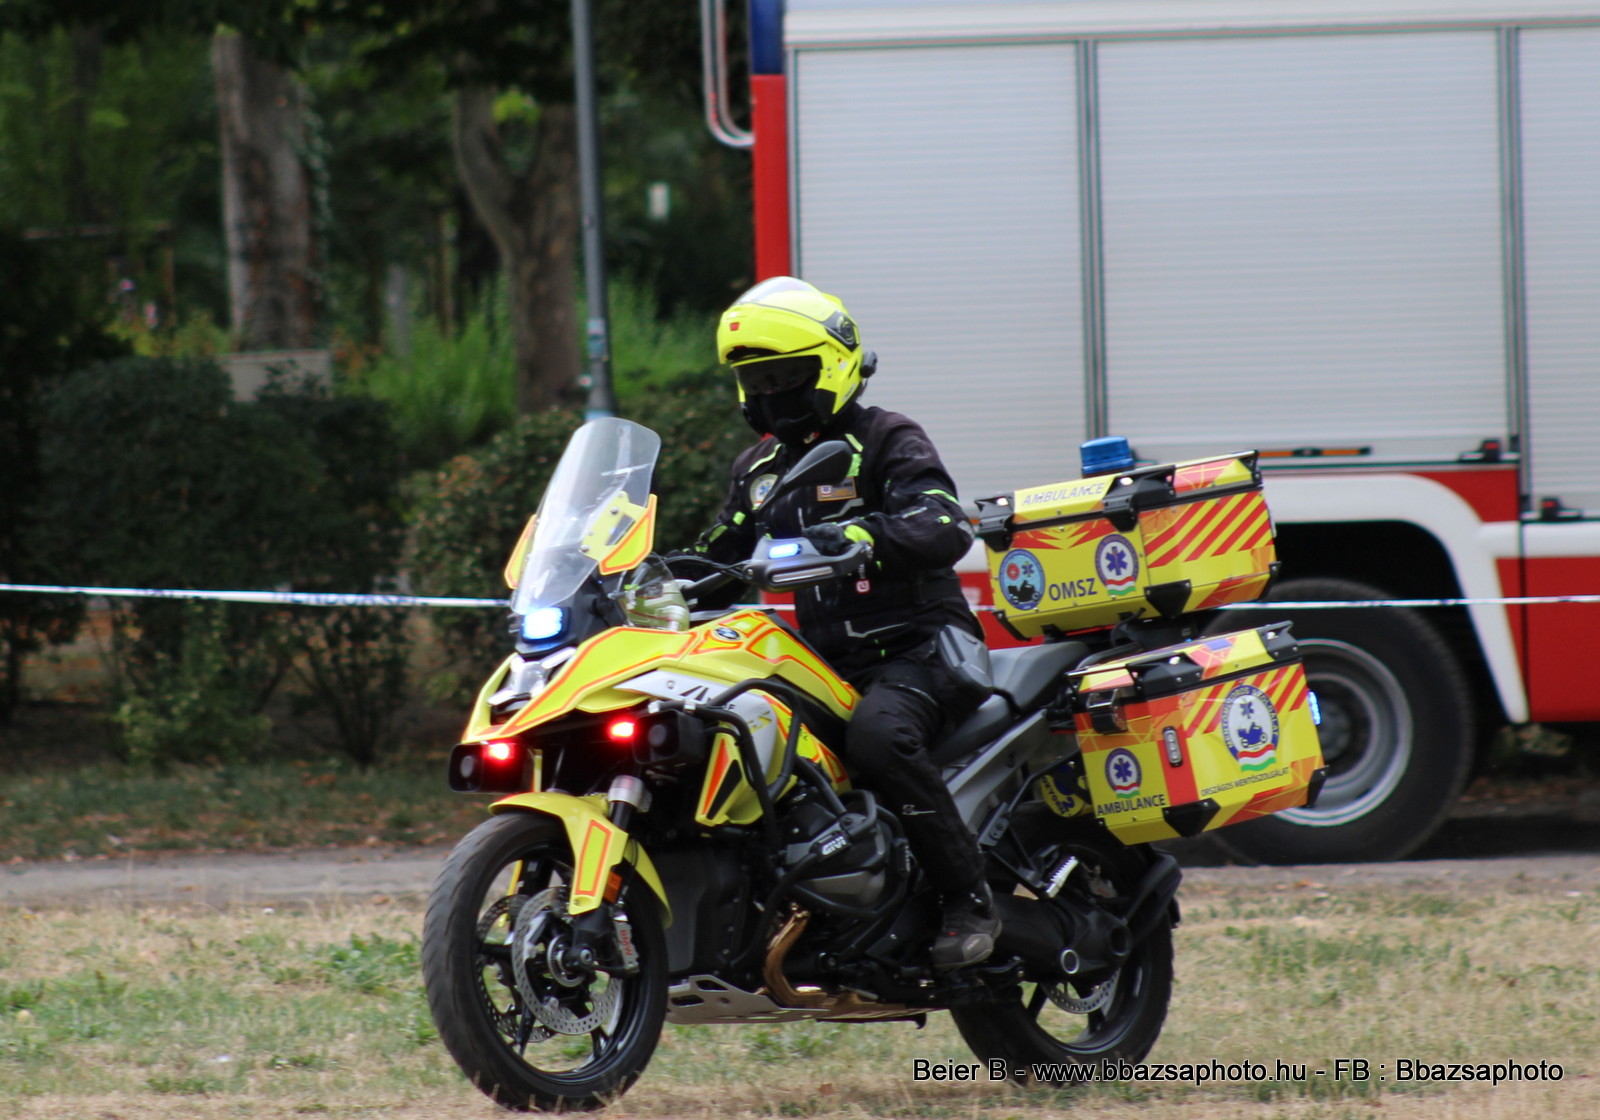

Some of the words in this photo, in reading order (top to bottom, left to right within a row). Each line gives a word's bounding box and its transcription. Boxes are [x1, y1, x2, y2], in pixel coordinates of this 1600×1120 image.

[1022, 483, 1105, 505] AMBULANCE
[1047, 577, 1098, 601] OMSZ
[1097, 794, 1166, 816] AMBULANCE
[821, 835, 847, 856] GIVI
